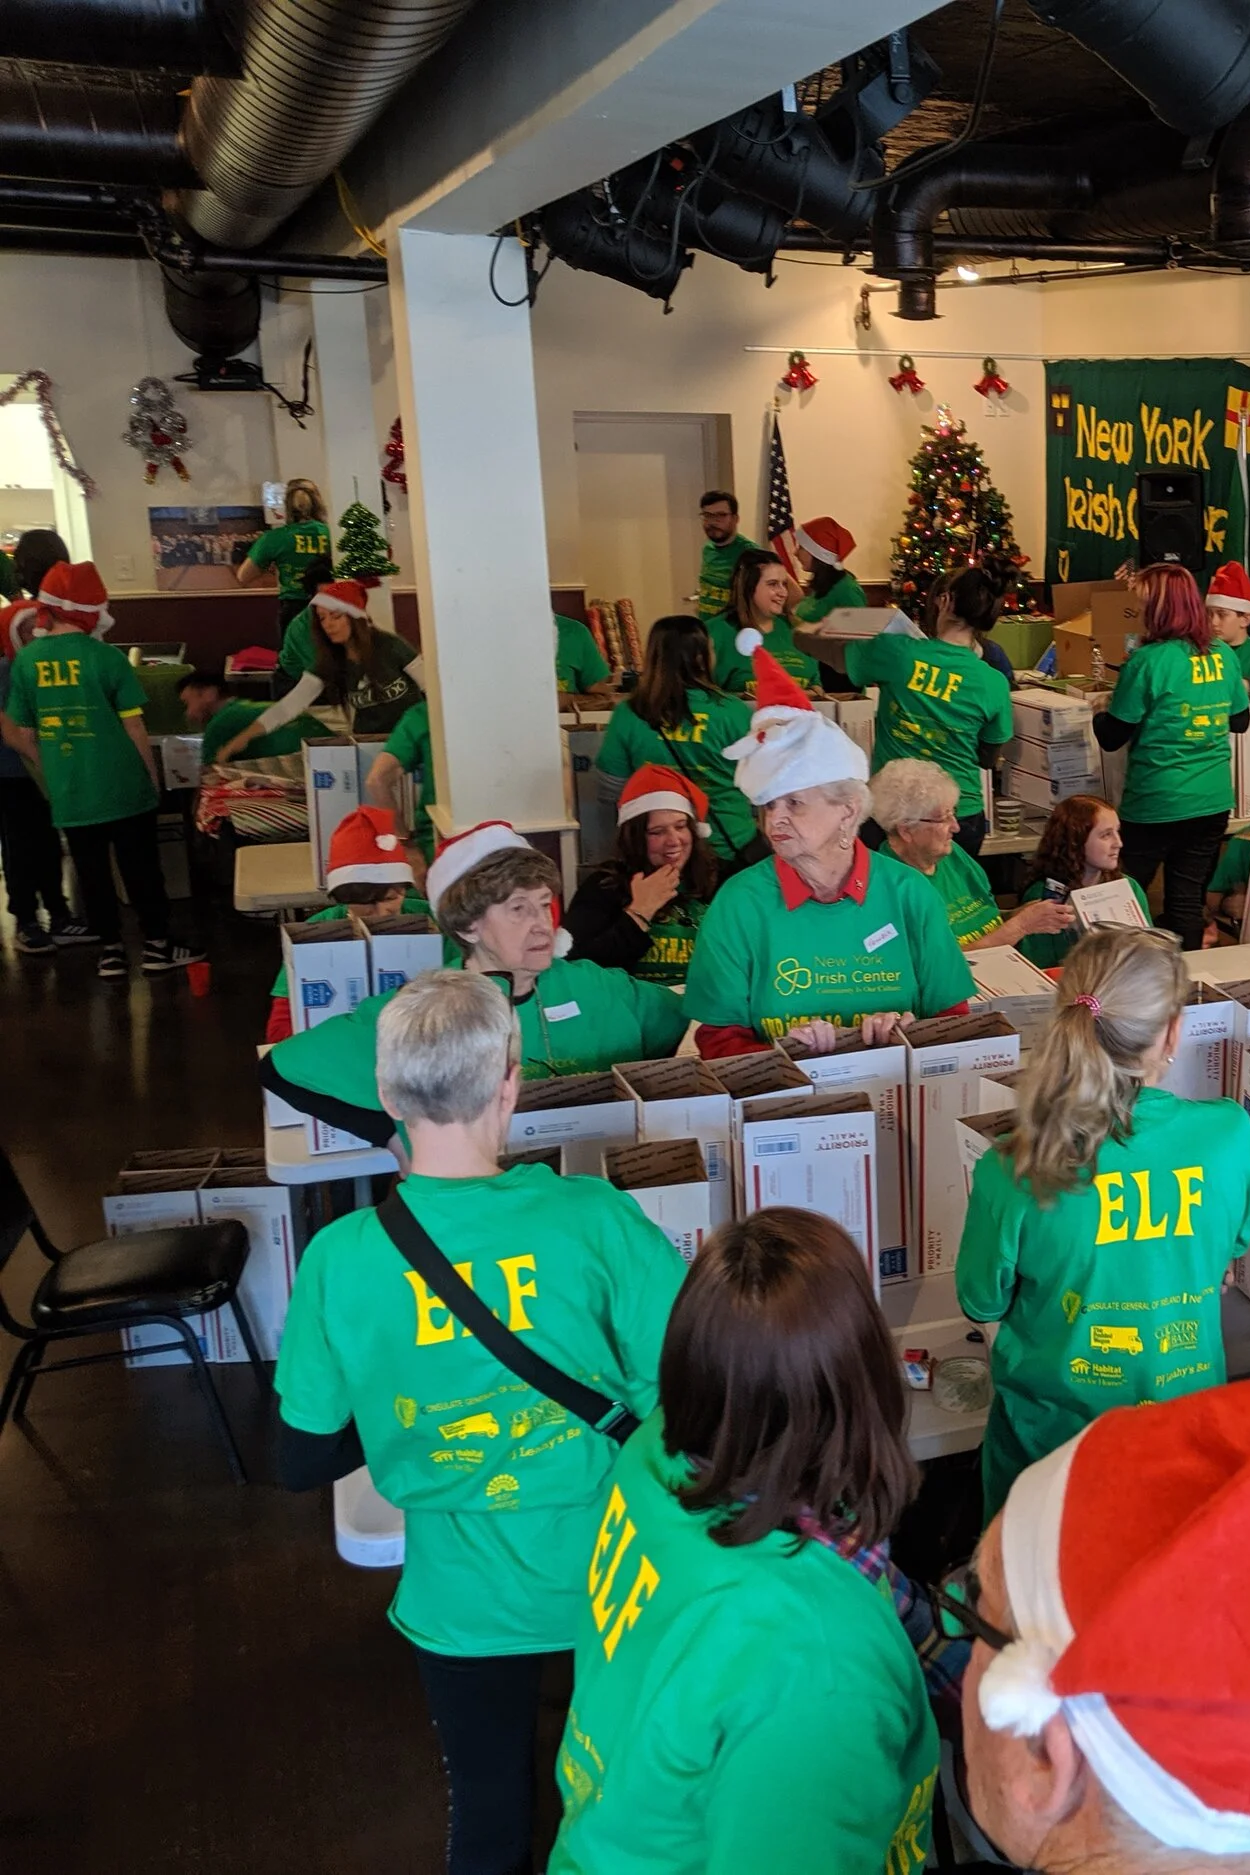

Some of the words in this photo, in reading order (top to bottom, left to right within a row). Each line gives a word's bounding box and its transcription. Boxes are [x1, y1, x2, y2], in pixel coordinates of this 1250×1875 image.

[1075, 403, 1134, 465] New
[295, 534, 327, 553] ELF
[36, 660, 81, 687] ELF
[907, 660, 963, 702] ELF
[1189, 653, 1224, 684] ELF
[814, 956, 847, 967] New
[853, 954, 884, 966] York
[815, 971, 847, 984] Irish
[852, 970, 901, 983] Center
[1187, 1026, 1228, 1037] PRIORITY
[971, 1060, 1014, 1070] PRIORITY
[1213, 1041, 1221, 1081] PRIORITY
[885, 1089, 894, 1132] PRIORITY
[816, 1139, 869, 1151] PRIORITY
[1093, 1166, 1205, 1245] ELF
[403, 1253, 538, 1346] EF
[1093, 1363, 1121, 1374] Habitat
[589, 1484, 660, 1662] ELF
